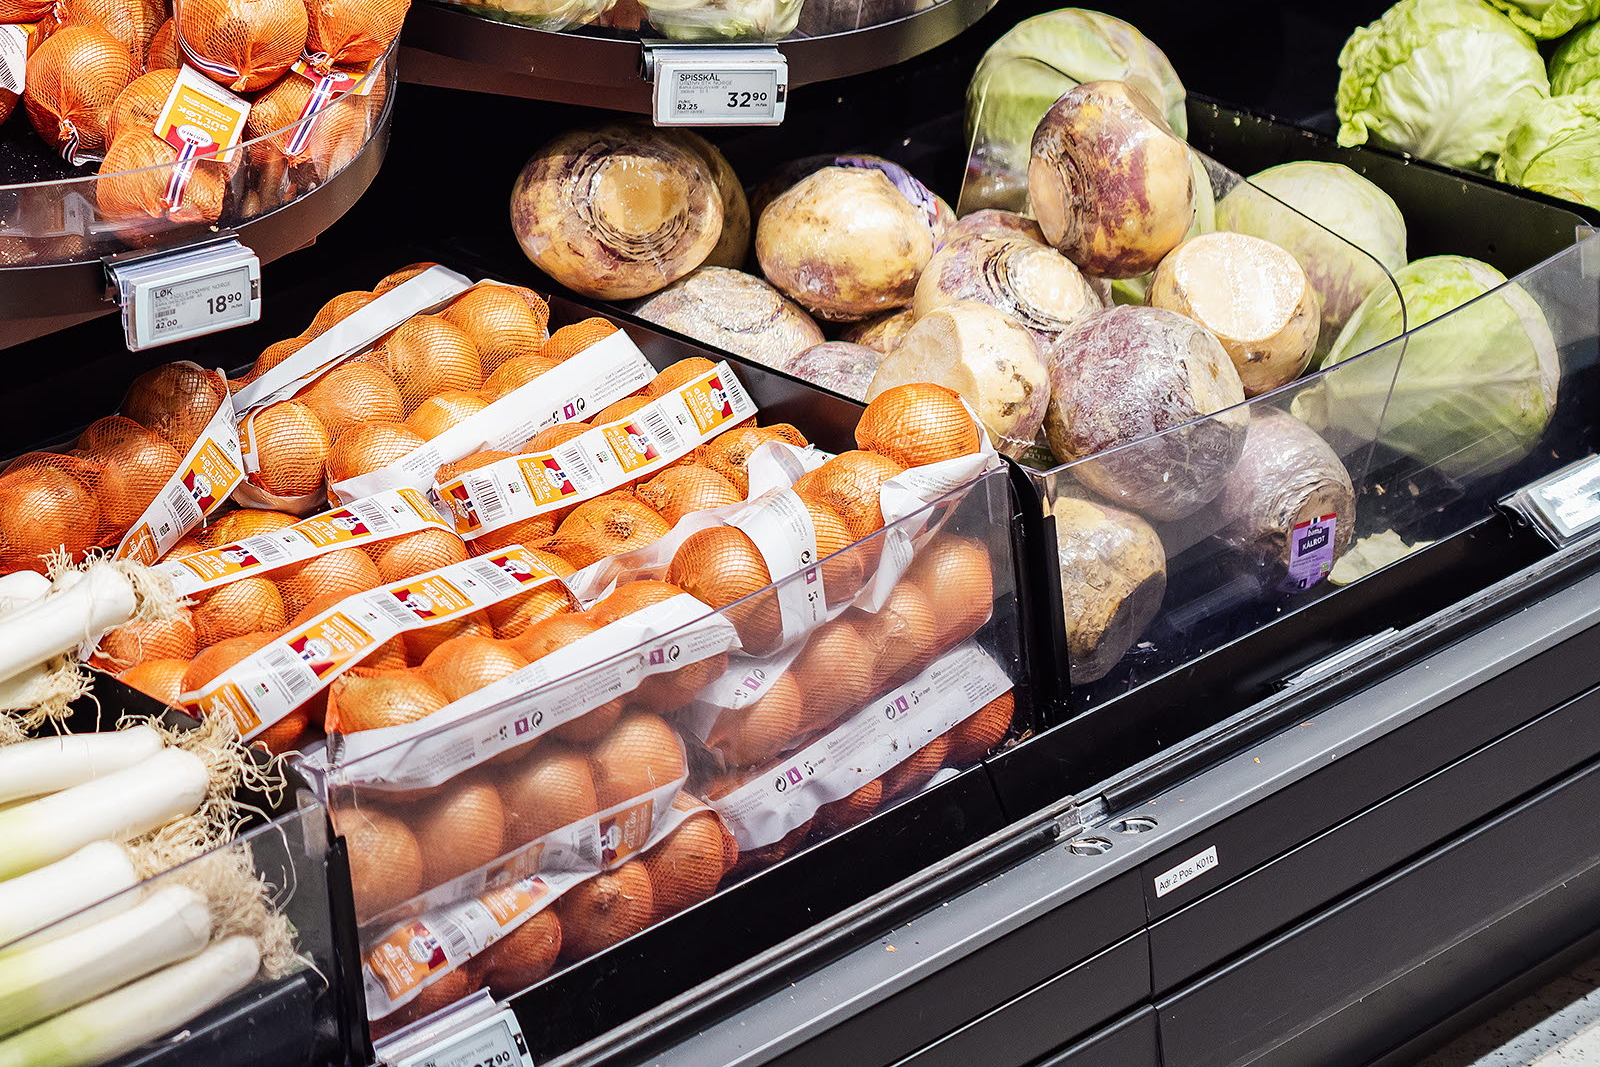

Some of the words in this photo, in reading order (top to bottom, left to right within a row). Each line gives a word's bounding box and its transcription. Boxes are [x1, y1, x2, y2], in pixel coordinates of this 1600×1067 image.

[679, 72, 720, 82] SPISSKÅL
[677, 103, 699, 111] 82.25
[726, 91, 768, 108] 3290
[176, 103, 202, 121] LØK
[183, 112, 217, 133] NORSK
[203, 115, 229, 133] GUL
[154, 287, 173, 299] LØK
[206, 291, 242, 314] 1890
[155, 319, 178, 330] 42.00
[197, 453, 216, 471] LØK
[199, 463, 222, 485] NORSK
[211, 469, 229, 487] GUL
[1302, 535, 1326, 550] KÅLROT
[1195, 855, 1215, 871] K01b
